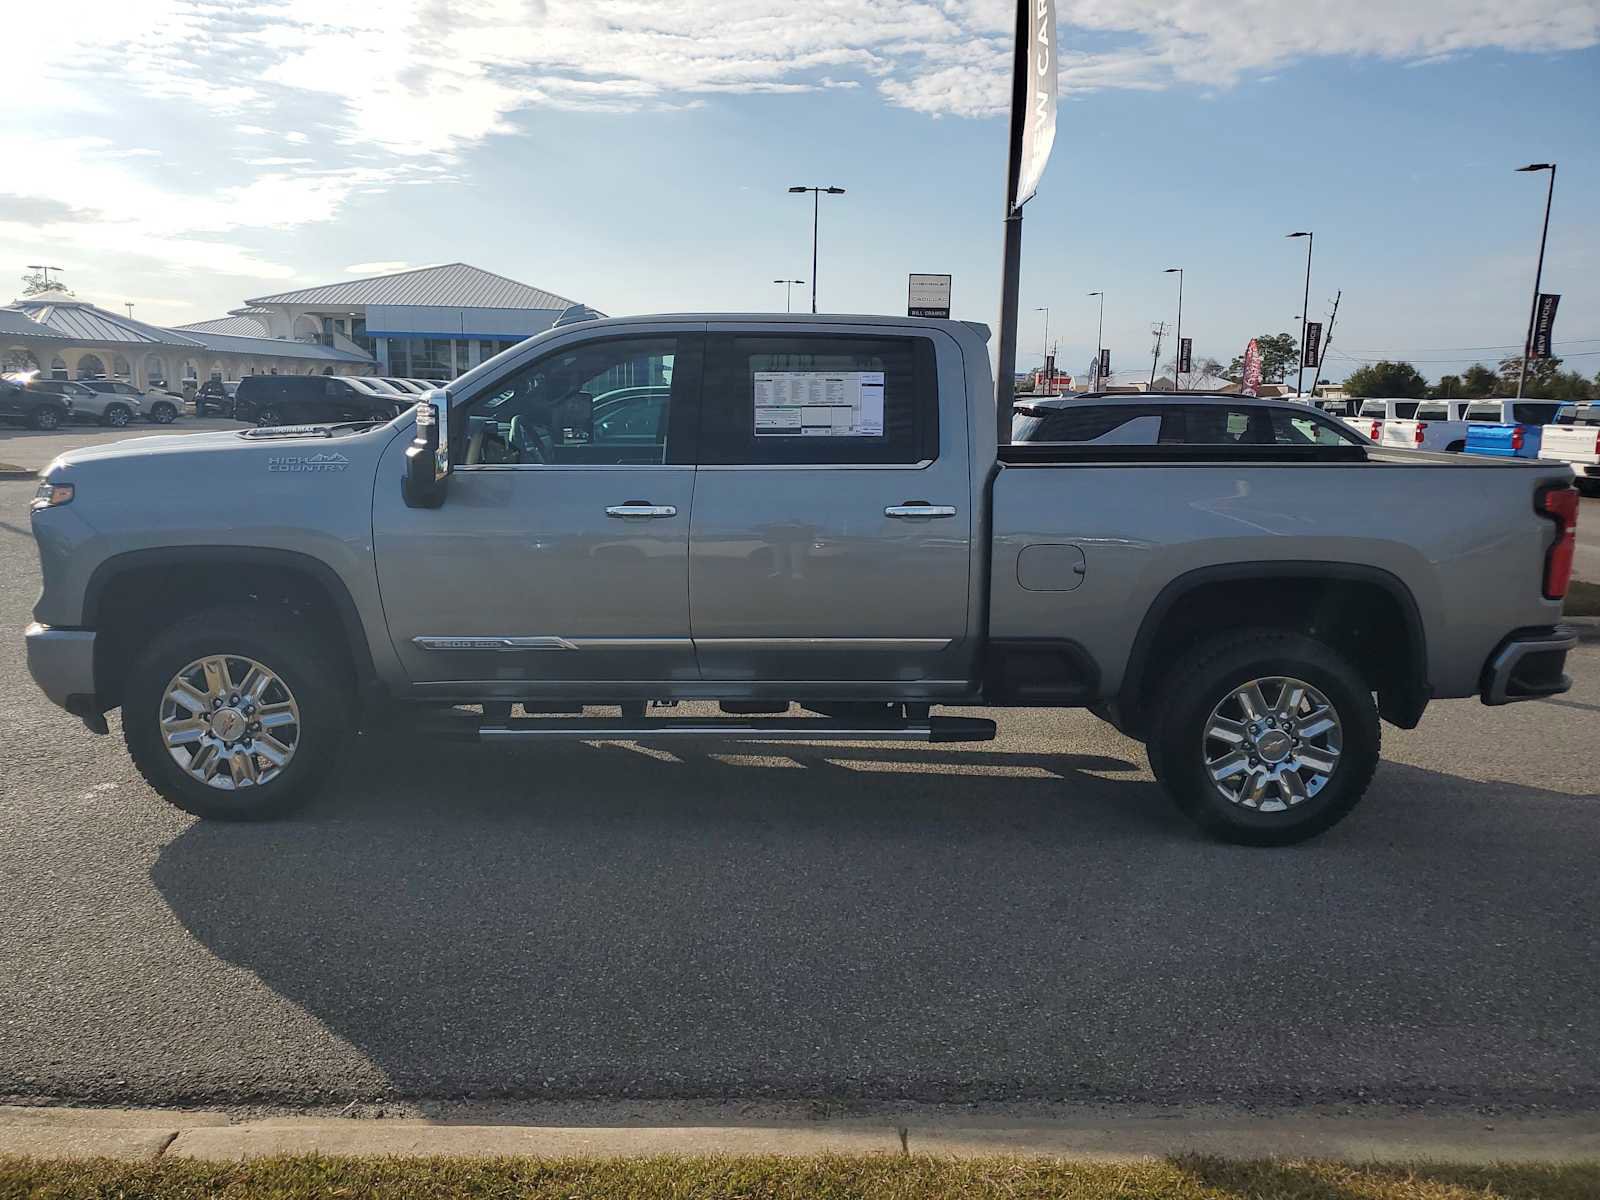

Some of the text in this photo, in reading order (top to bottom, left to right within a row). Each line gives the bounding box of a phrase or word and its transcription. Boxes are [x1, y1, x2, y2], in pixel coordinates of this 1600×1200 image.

[1537, 297, 1553, 355] NEW TRUCKS
[268, 456, 308, 464] HIGH
[268, 464, 348, 472] COUNTRY
